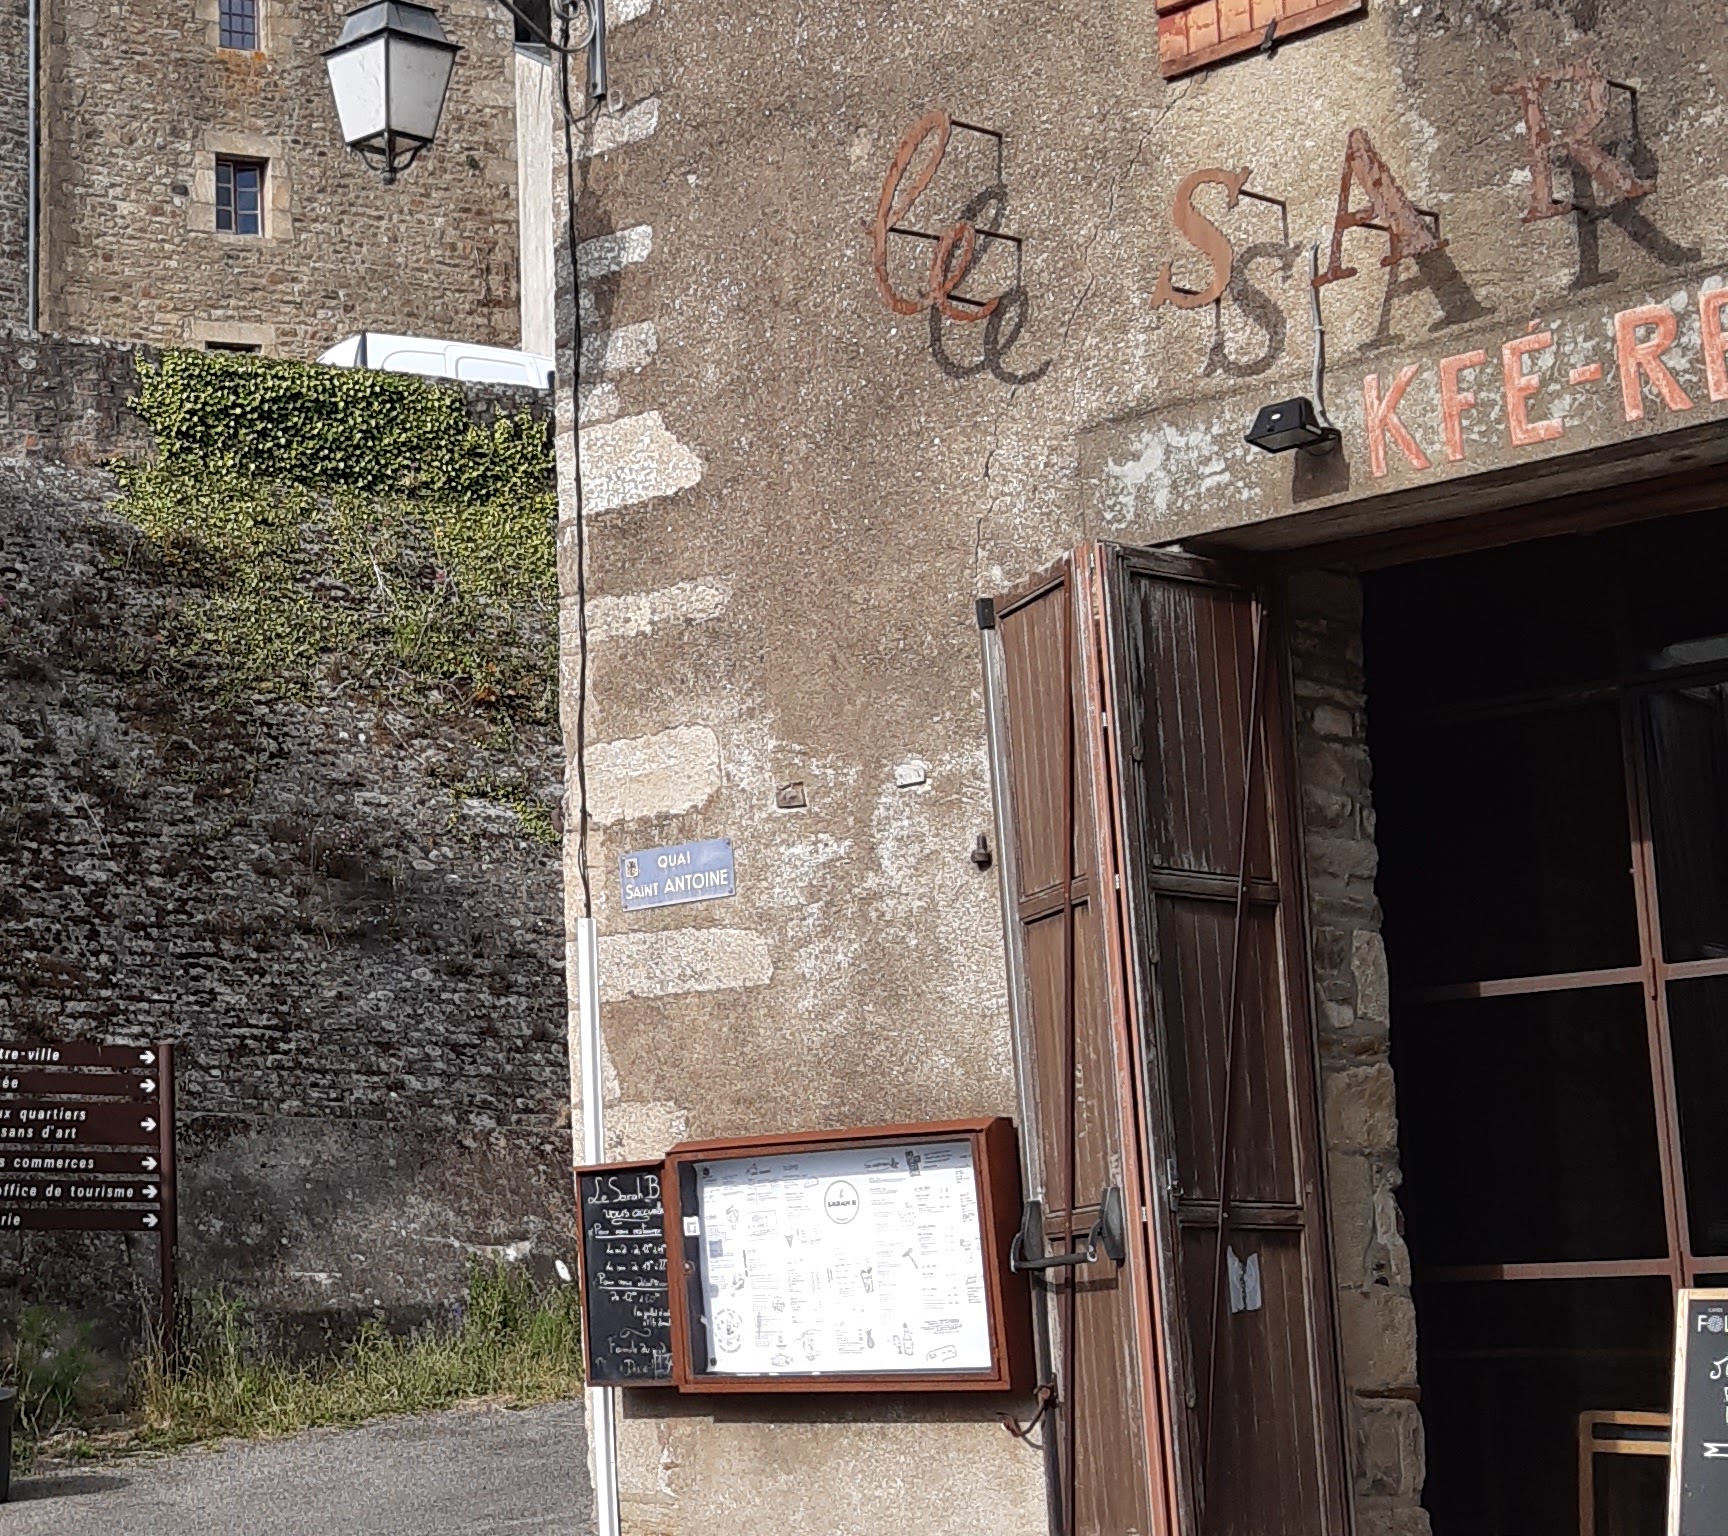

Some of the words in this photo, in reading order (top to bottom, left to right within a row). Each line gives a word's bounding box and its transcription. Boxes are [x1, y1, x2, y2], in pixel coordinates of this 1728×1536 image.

[657, 850, 691, 869] QUAI
[663, 868, 729, 894] ANTOINE
[19, 1107, 87, 1122] quartiers
[41, 1125, 77, 1139] d'art
[13, 1157, 95, 1169] commerces
[45, 1184, 62, 1197] de
[70, 1185, 134, 1198] tourisme
[588, 1176, 610, 1204] Le
[608, 1176, 643, 1202] Sarah
[643, 1174, 660, 1199] B
